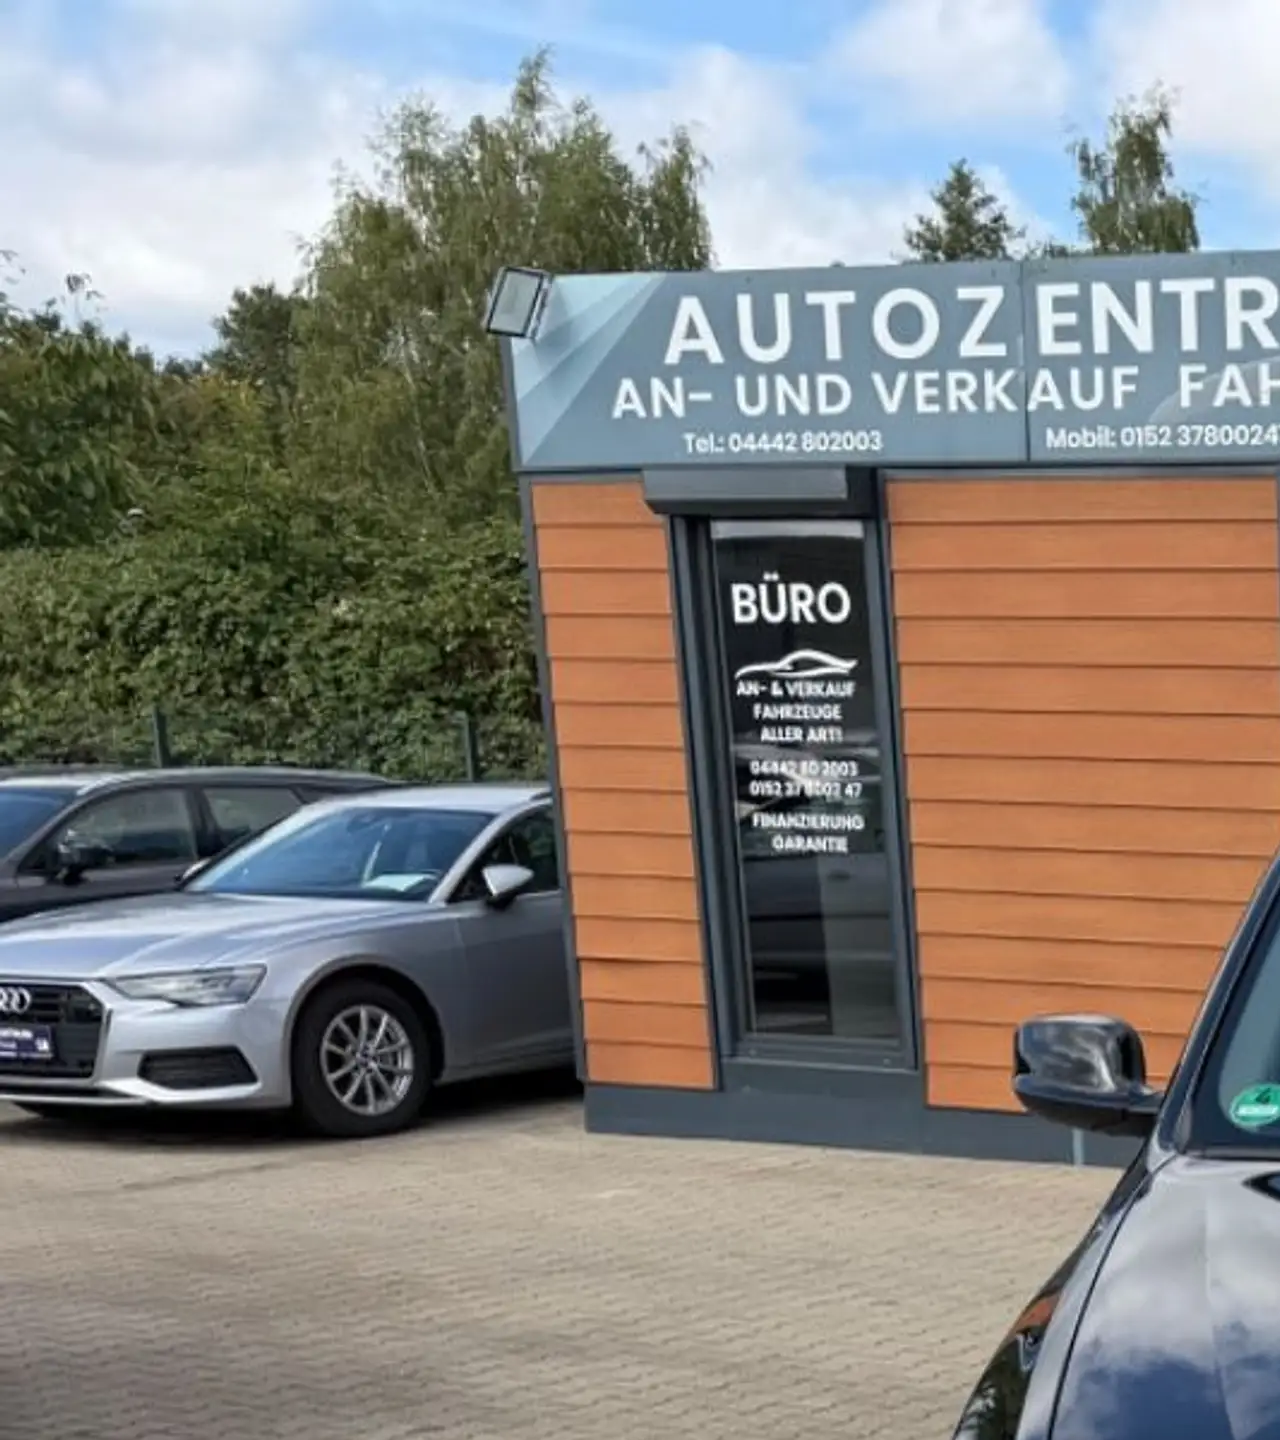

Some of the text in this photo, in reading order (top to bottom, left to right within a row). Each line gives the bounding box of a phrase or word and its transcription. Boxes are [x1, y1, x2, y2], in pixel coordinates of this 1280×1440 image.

[612, 377, 712, 419] AN-
[735, 373, 852, 416] UND
[871, 364, 1138, 415] VERKAUF
[683, 430, 883, 454] Tel.: 04442 802003
[1046, 426, 1117, 449] Mobil:
[1120, 424, 1172, 448] 0152
[732, 571, 851, 624] BÜRO
[785, 681, 856, 697] VERKAUF
[753, 703, 844, 720] FAHRZEUGE
